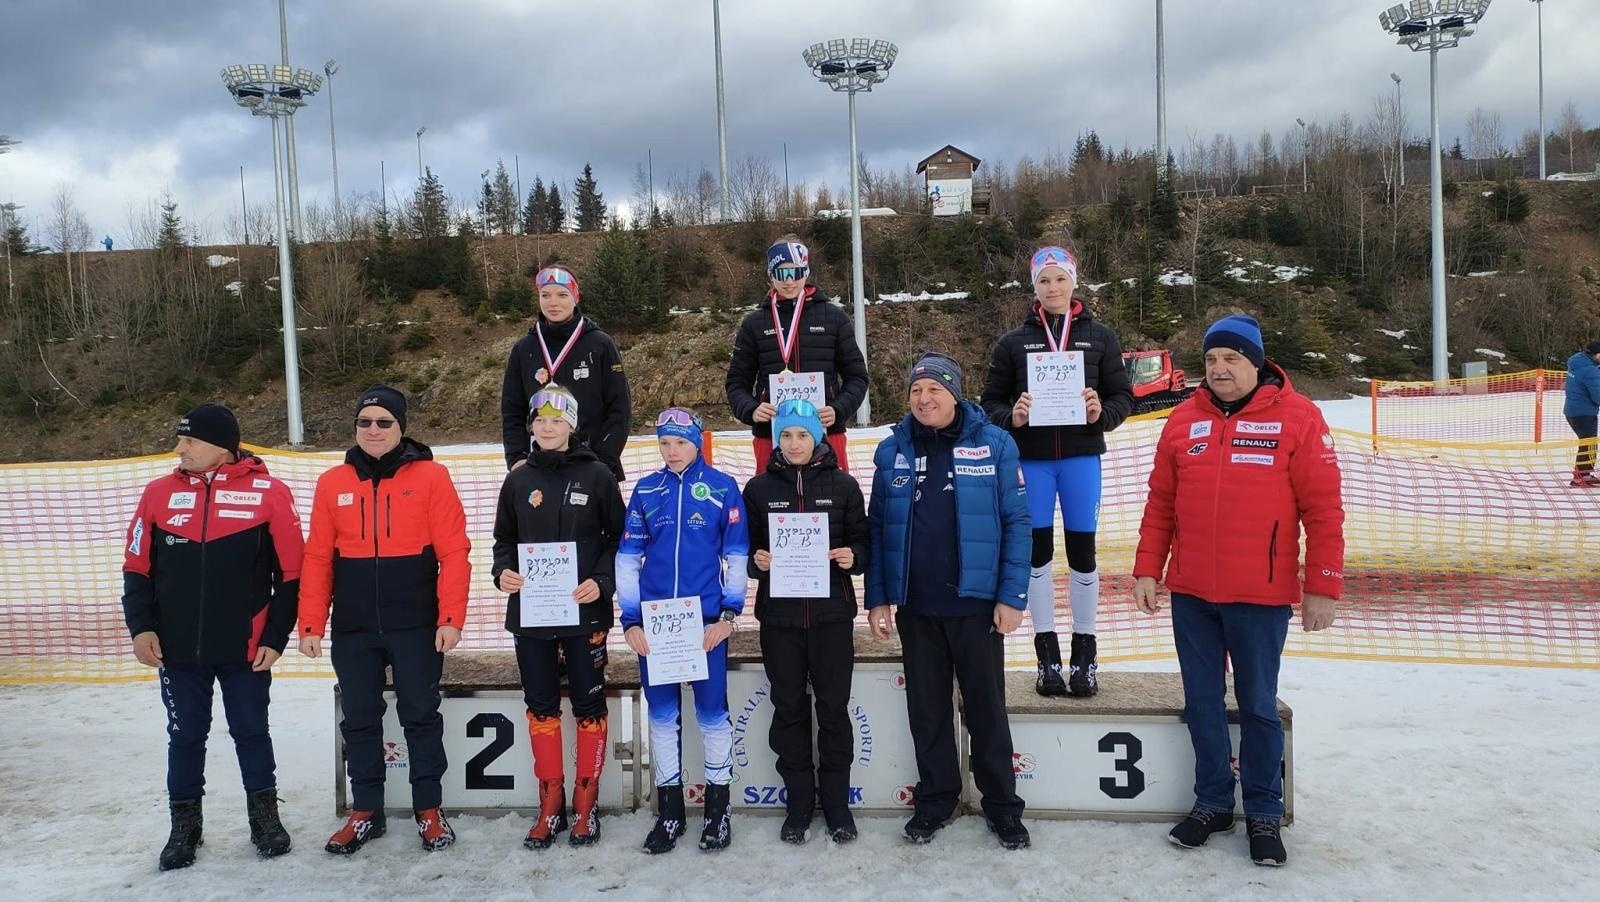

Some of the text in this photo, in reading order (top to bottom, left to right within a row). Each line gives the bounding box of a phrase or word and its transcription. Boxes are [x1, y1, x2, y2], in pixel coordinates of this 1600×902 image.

[1035, 364, 1077, 372] DYPLOM
[777, 387, 818, 396] DYPLOM
[1232, 439, 1278, 448] RENAULT
[957, 467, 994, 475] RENAULT
[777, 528, 821, 536] DYPLOM
[526, 557, 570, 566] DYPLOM
[650, 611, 695, 623] DYPLOM
[734, 683, 769, 767] CENTRALN
[852, 705, 872, 767] SPORTU
[465, 713, 515, 790] 2
[1098, 732, 1145, 799] 3
